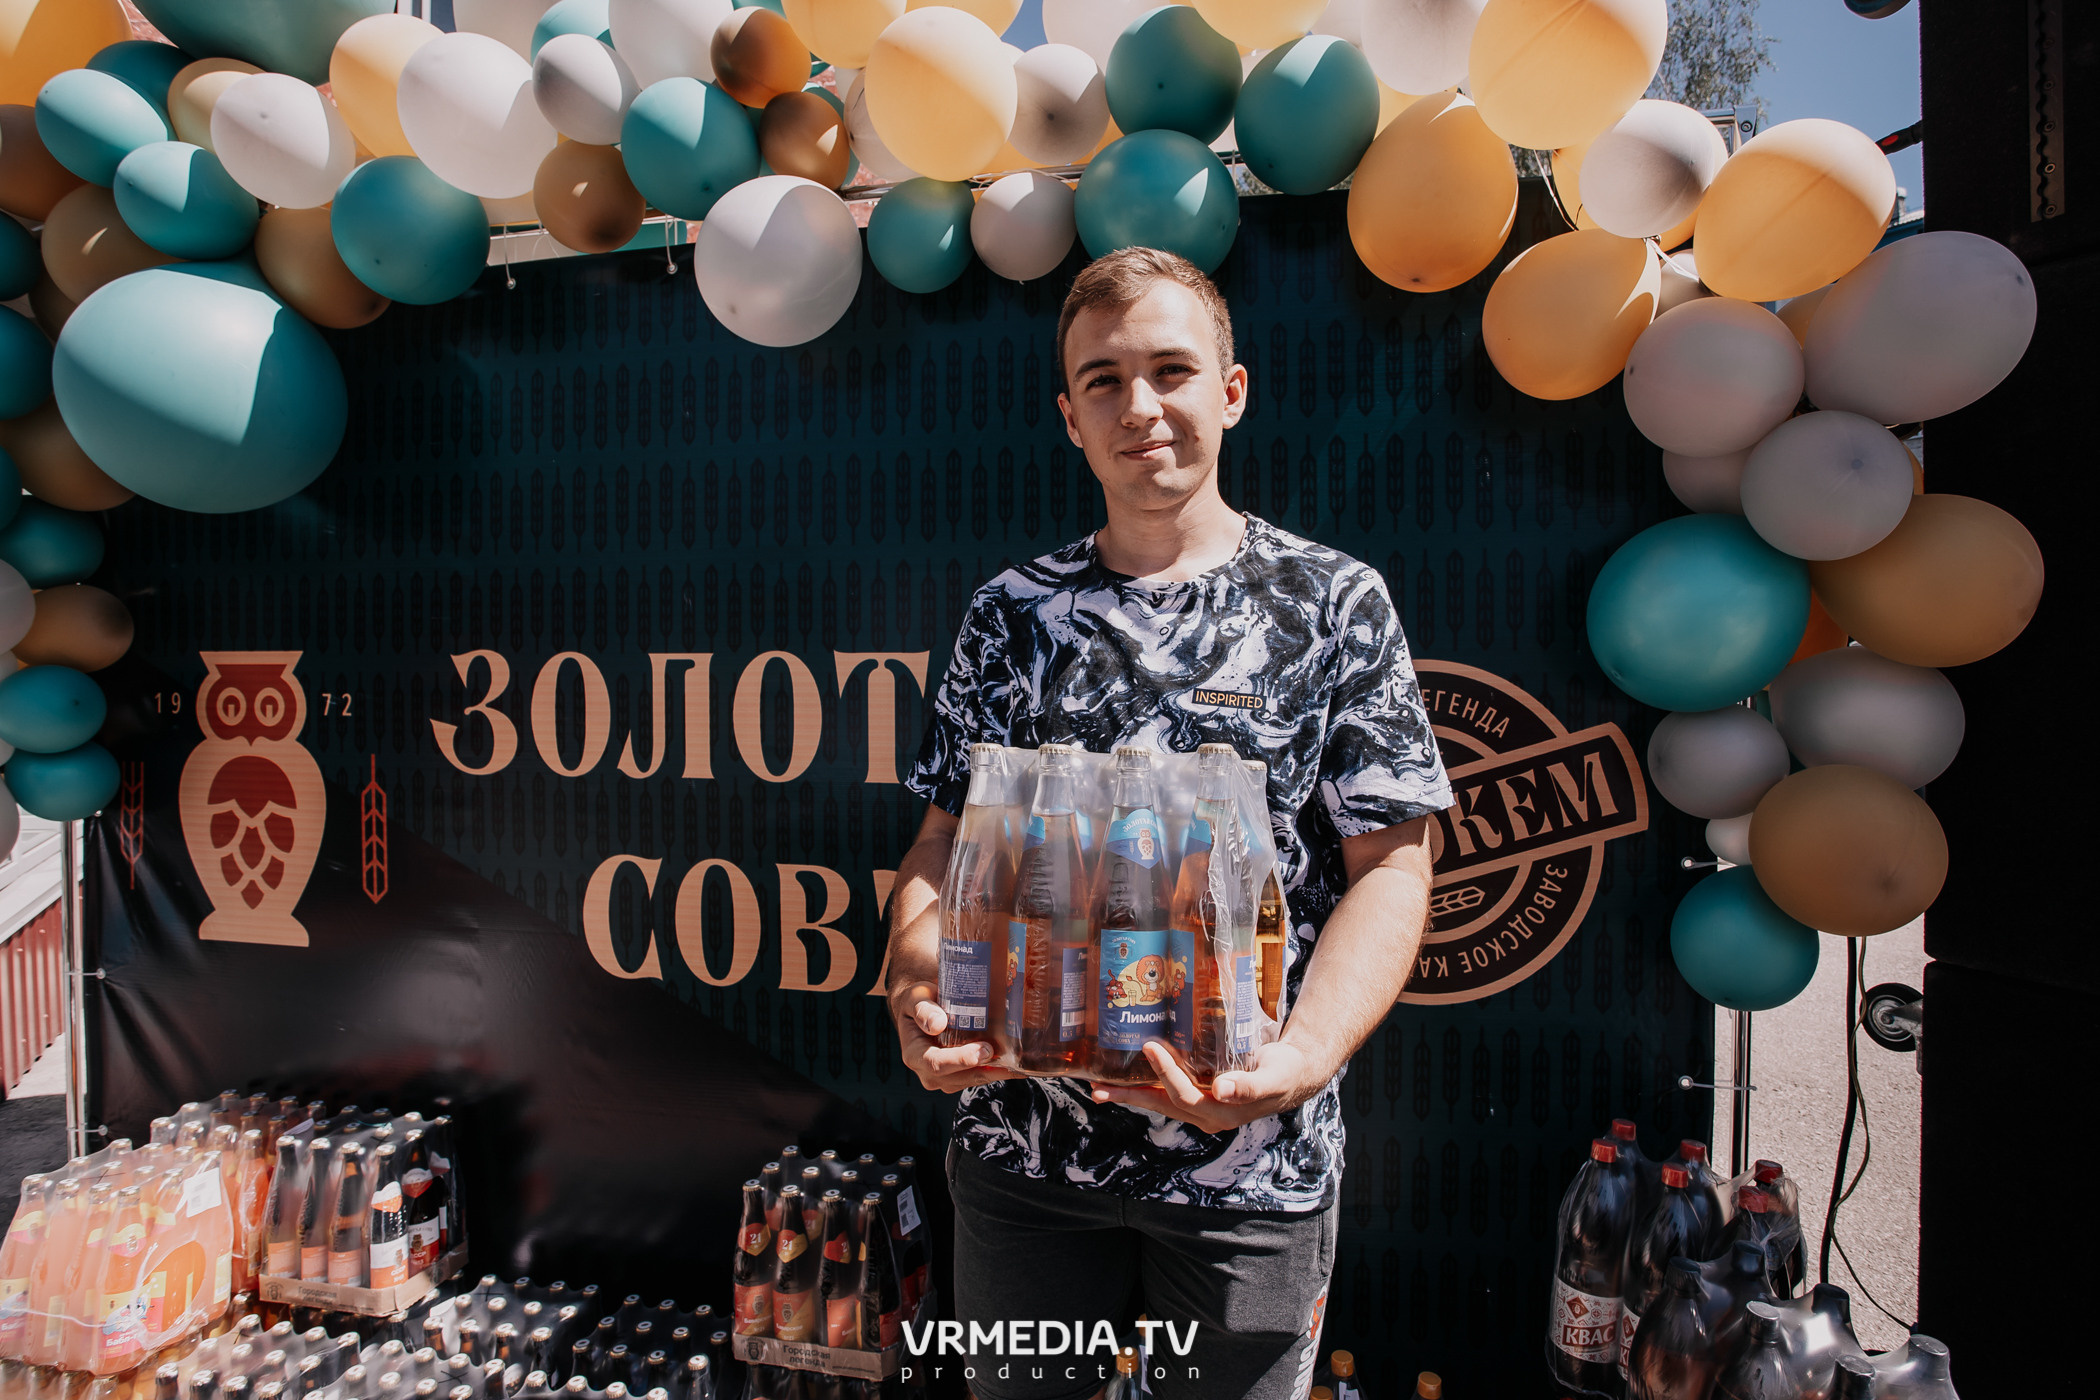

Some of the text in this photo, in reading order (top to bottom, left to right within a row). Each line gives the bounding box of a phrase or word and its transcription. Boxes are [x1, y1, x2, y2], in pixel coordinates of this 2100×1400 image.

[154, 692, 352, 716] 19 72
[1195, 690, 1263, 708] INSPIRITED
[430, 649, 930, 784] ЗОЛОТ
[1421, 688, 1510, 738] ЕГЕНДА
[1418, 864, 1568, 978] ЗАВОДСКОЕ КА
[750, 1232, 762, 1244] 21
[782, 1239, 793, 1251] 21
[1566, 1325, 1614, 1345] КВАС
[783, 1345, 831, 1360] Городская
[789, 1355, 826, 1369] легенда
